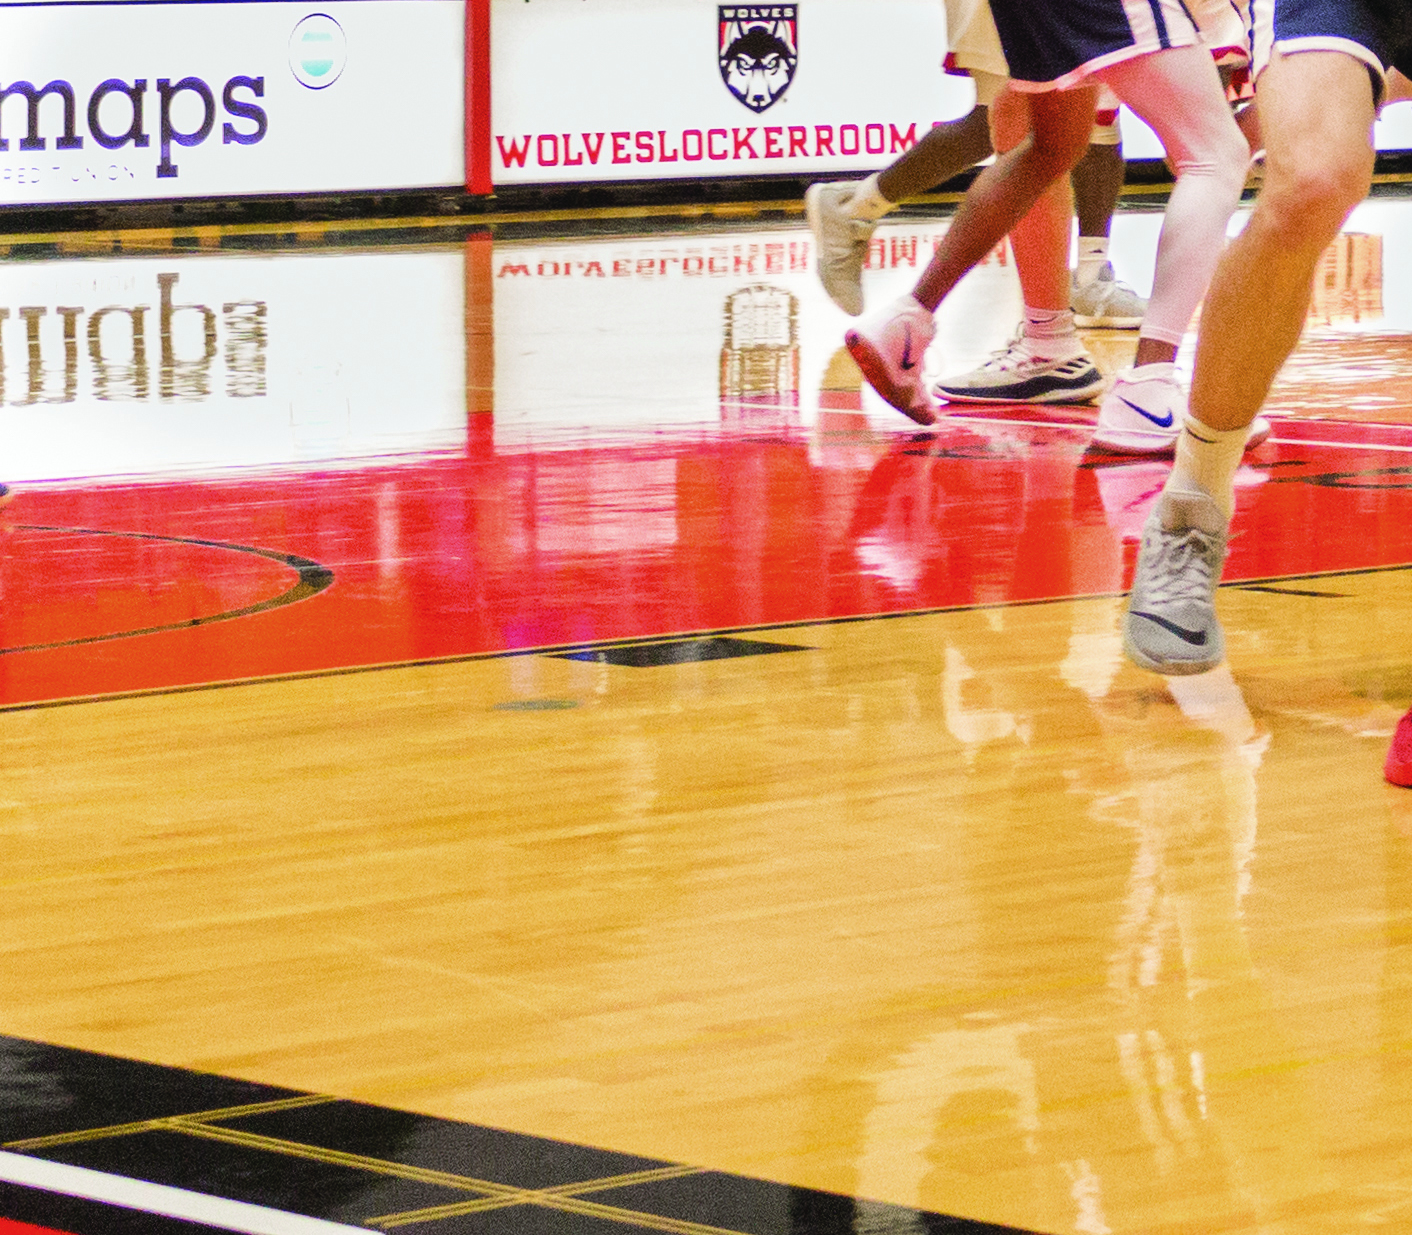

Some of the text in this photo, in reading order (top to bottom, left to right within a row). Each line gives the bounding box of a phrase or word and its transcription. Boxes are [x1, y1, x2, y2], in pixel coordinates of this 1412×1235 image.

[722, 6, 795, 20] WOLVES
[0, 76, 268, 179] maps
[496, 122, 942, 168] WOLVESLOCKERROOM
